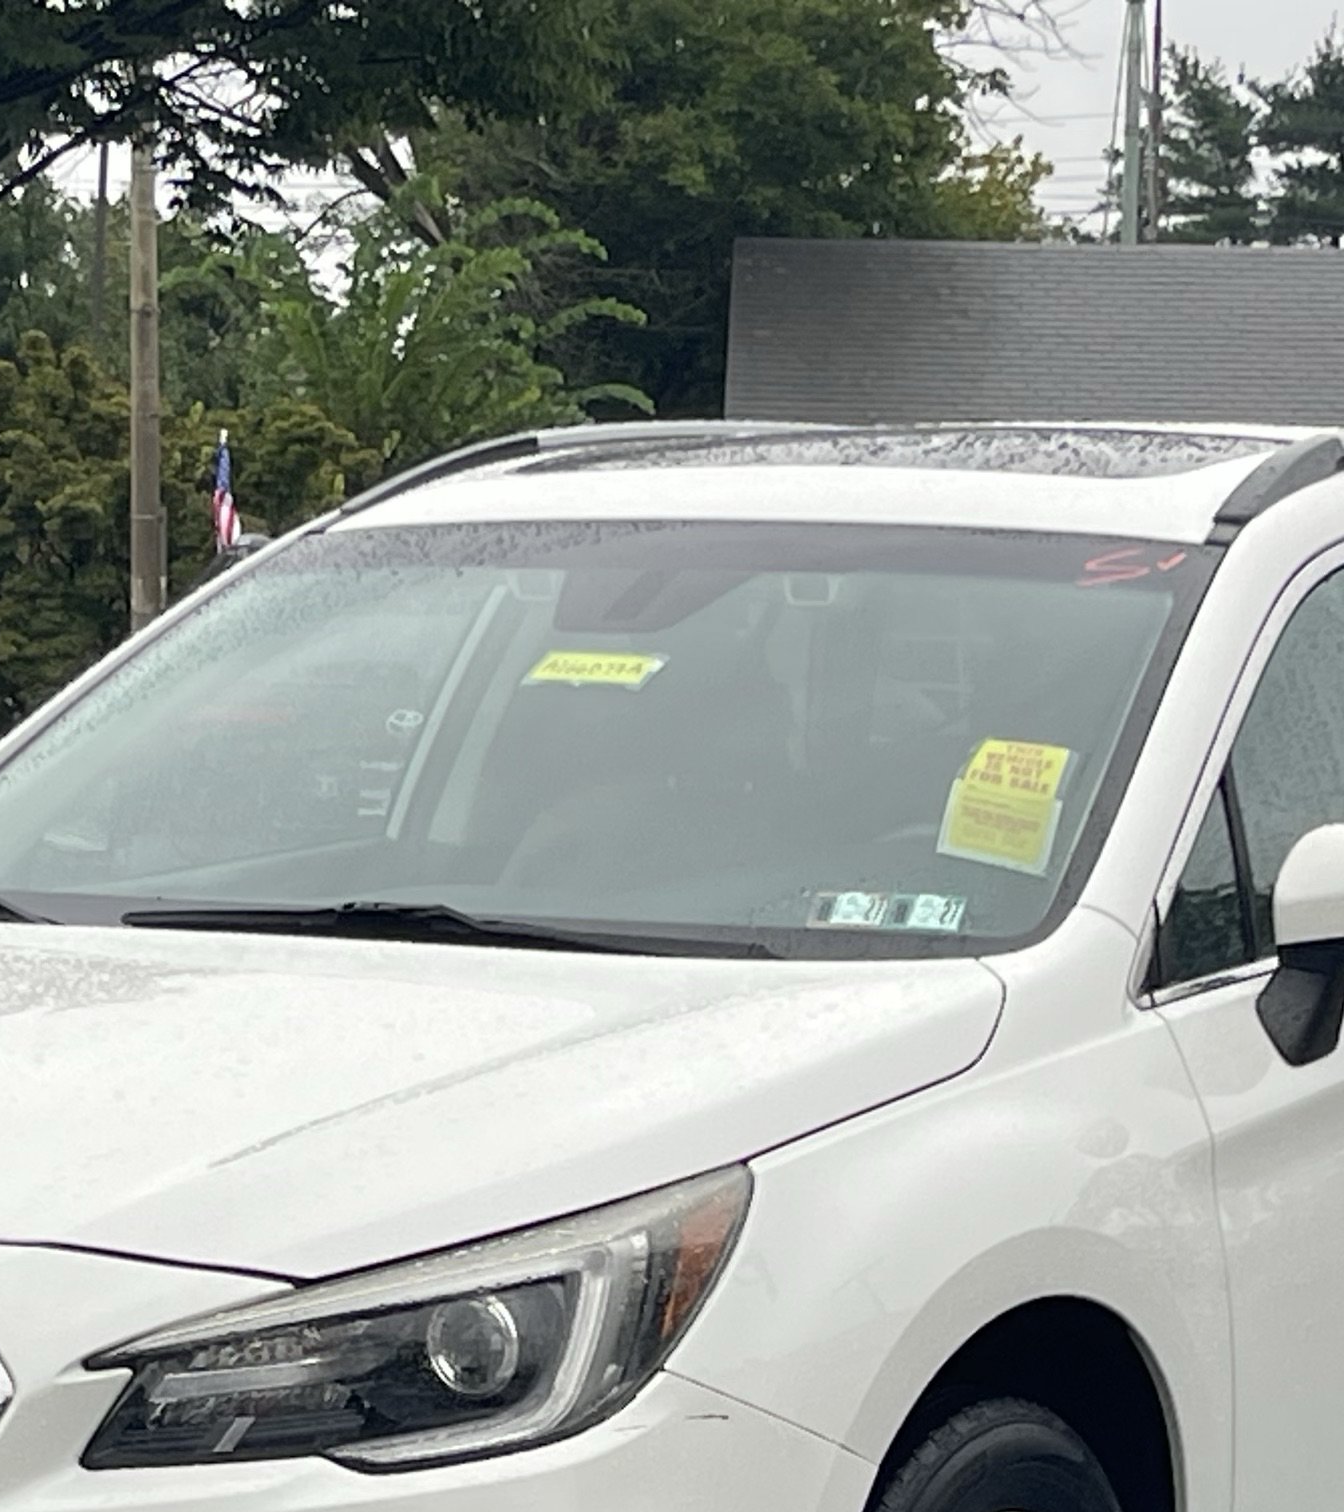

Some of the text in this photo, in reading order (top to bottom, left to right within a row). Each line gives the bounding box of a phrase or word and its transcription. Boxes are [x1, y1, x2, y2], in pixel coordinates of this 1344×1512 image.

[970, 769, 1050, 794] FOR SALE
[1009, 765, 1043, 779] NOT
